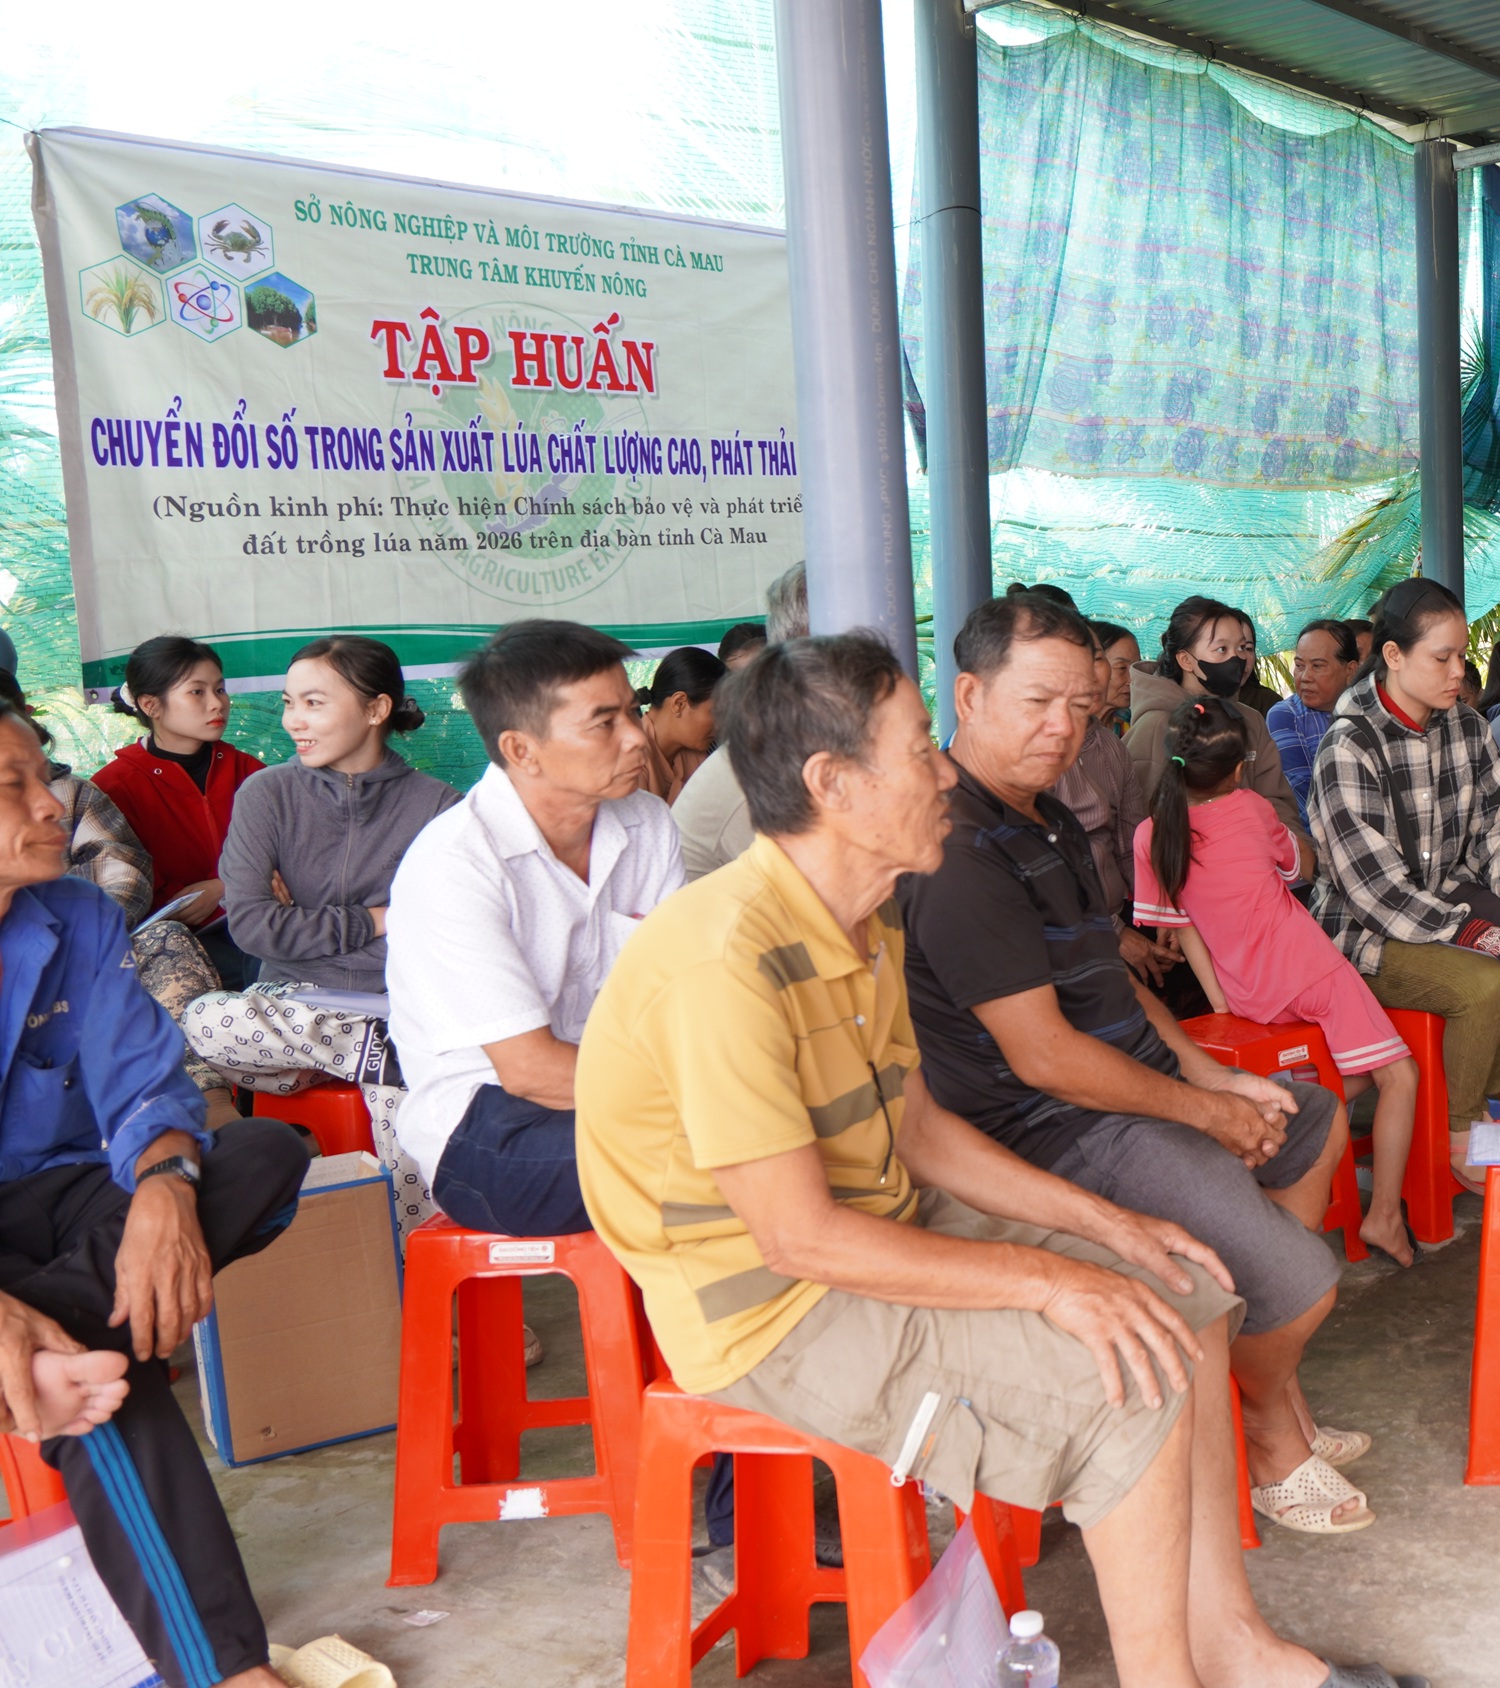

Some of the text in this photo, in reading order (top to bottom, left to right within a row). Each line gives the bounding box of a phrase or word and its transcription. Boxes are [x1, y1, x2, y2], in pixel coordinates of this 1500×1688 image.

[294, 193, 724, 273] SỞ NÔNG NGHIỆP VÀ MÔI TRƯỜNG TỈNH CÀ MAU
[406, 253, 648, 298] TRUNG TÂM KHUYẾN NÔNG
[371, 306, 490, 396] TẬP
[508, 312, 655, 394] HUẤN
[91, 395, 797, 483] CHUYỂN ĐỔI SỐ TRONG SẢN XUẤT LÚA CHẤT LƯỢNG CAO, PHÁT THẢI
[153, 492, 803, 523] (Nguồn kinh phí: Thực hiện Chính sách bảo vệ và phát triể
[242, 527, 768, 558] đất trồng lúa năm 2026 trên địa bàn tỉnh Cà Mau
[454, 545, 592, 597] AGRICULTURE
